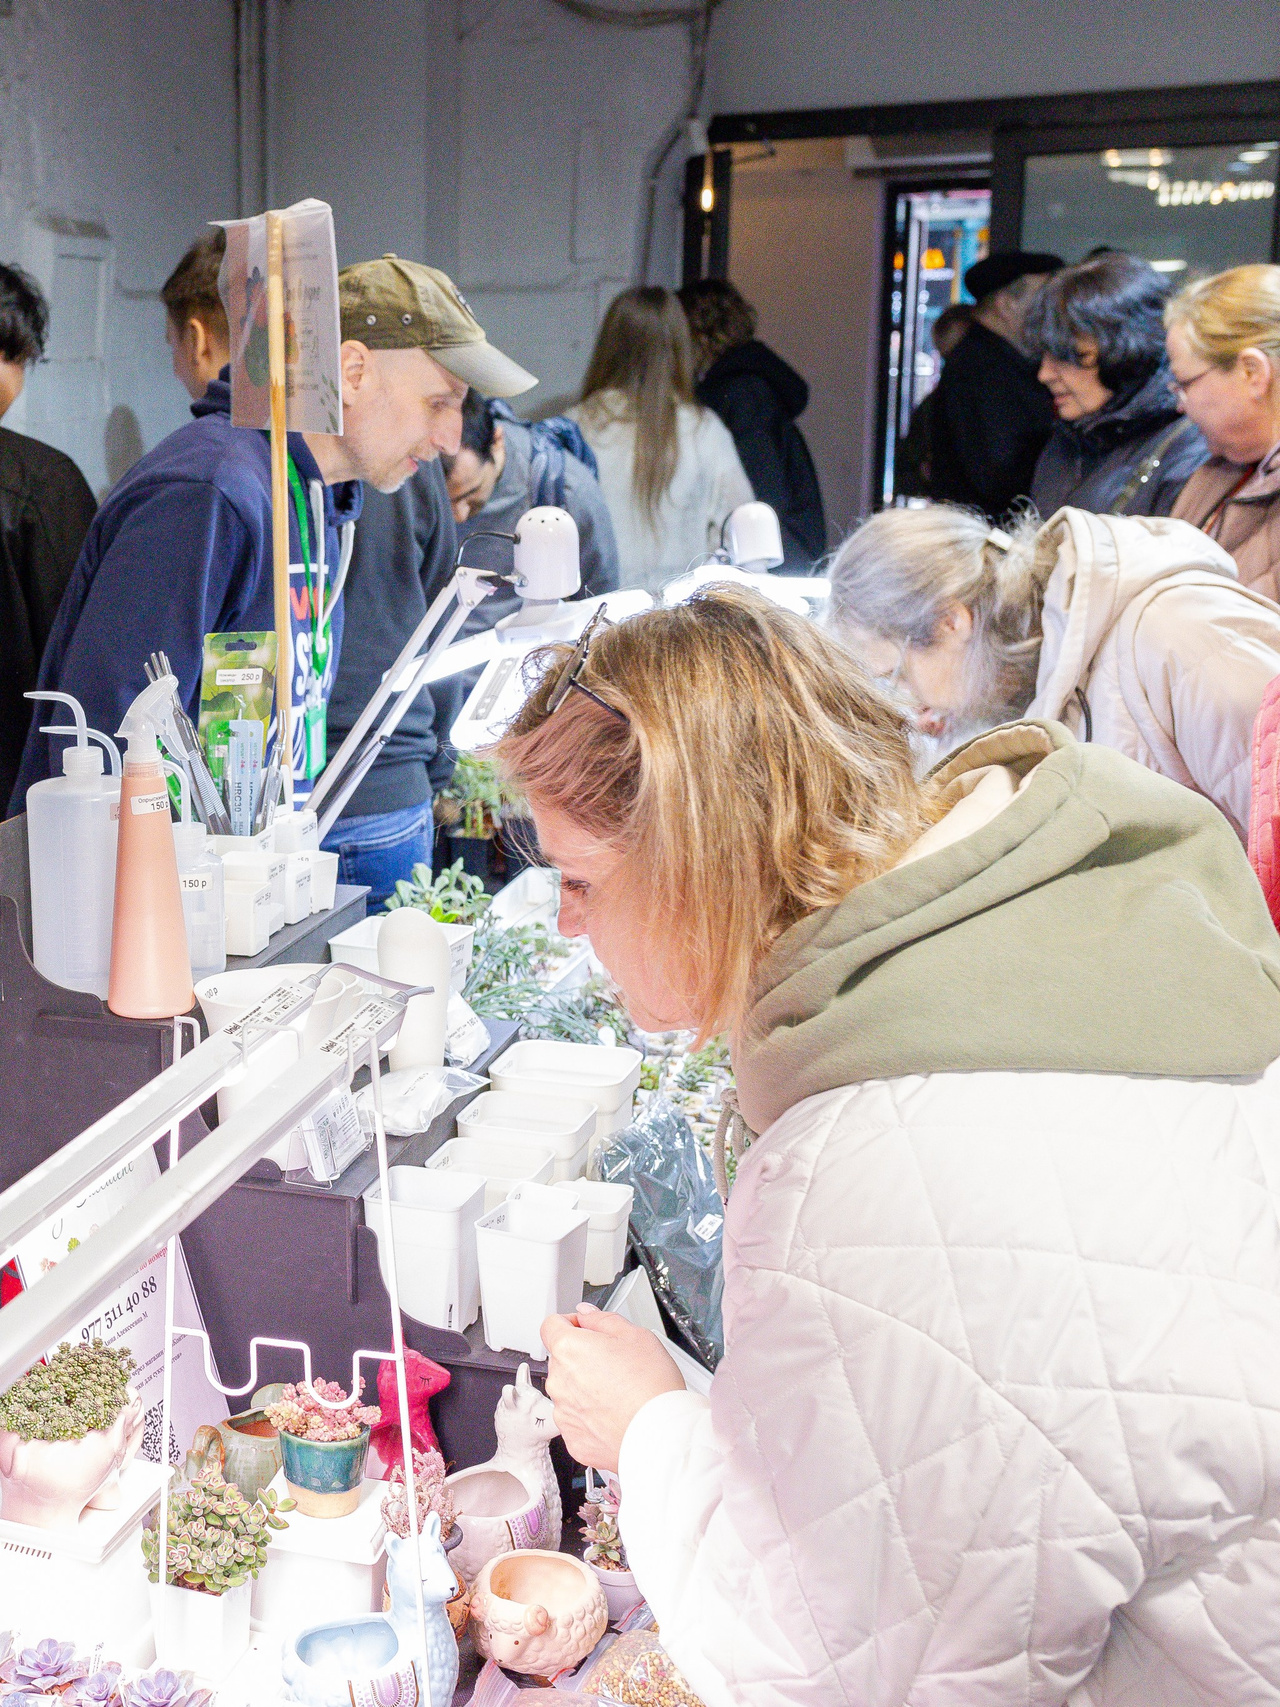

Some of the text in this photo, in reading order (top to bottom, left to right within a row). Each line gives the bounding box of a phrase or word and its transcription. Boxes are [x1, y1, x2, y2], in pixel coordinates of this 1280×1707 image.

[241, 673, 254, 681] 250
[151, 801, 165, 811] 150
[183, 879, 200, 888] 150
[148, 1247, 168, 1264] номер
[82, 1317, 104, 1344] 977
[105, 1303, 123, 1330] 511
[126, 1291, 141, 1314] 40
[141, 1275, 158, 1299] 88
